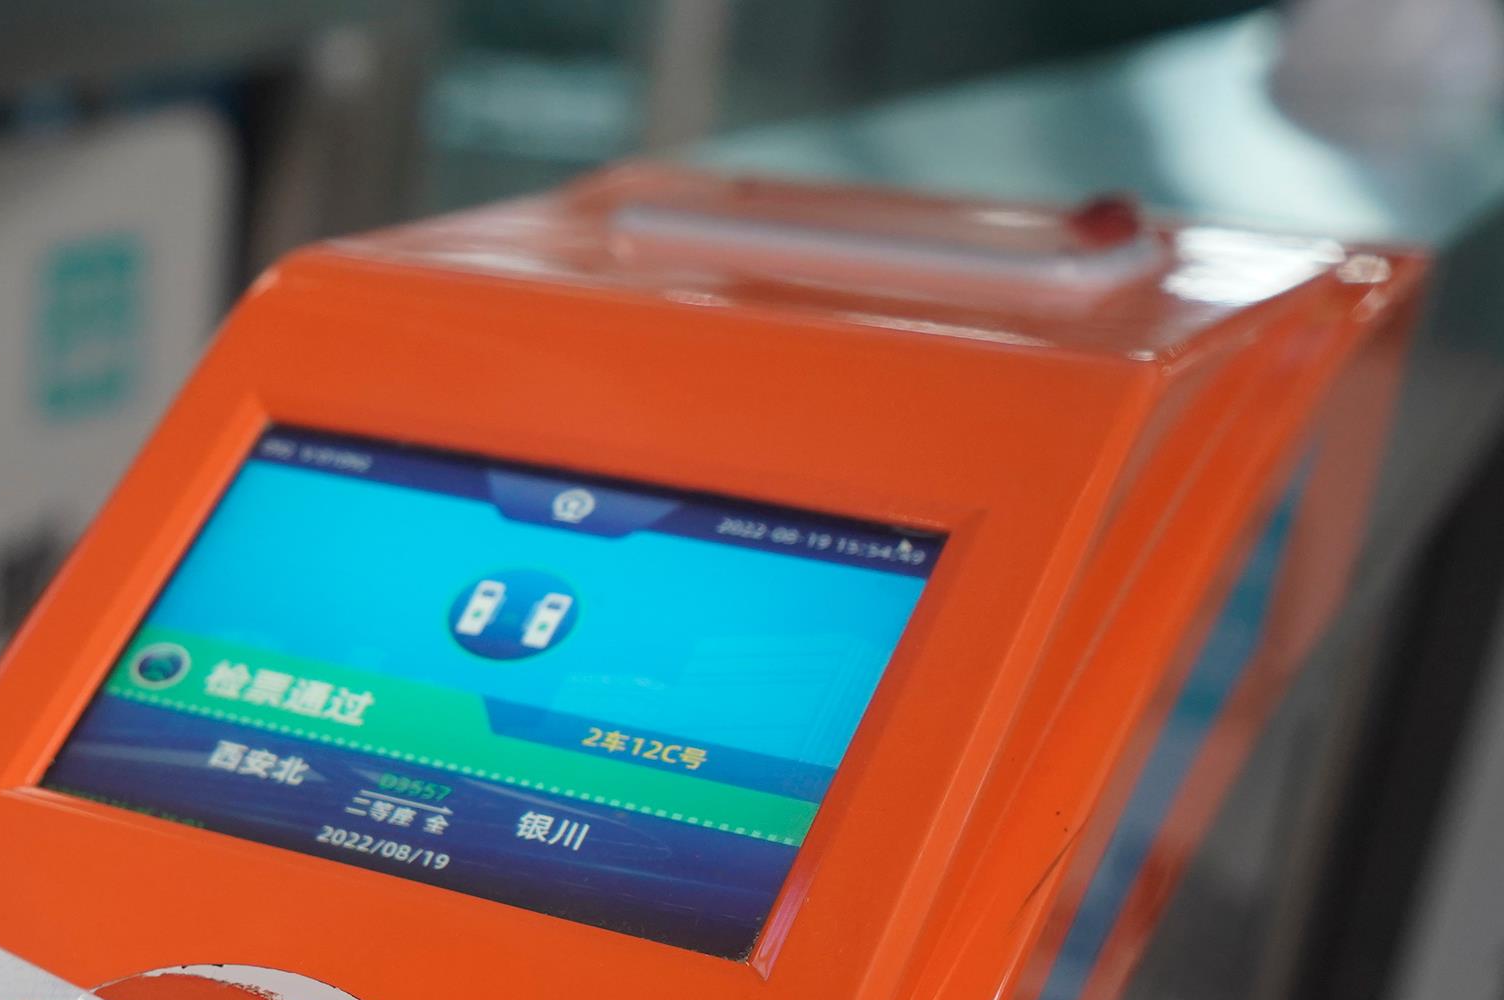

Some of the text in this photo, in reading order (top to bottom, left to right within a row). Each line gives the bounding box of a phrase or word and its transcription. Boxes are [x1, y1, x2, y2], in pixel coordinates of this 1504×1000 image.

[204, 660, 375, 726] 检票通过
[208, 739, 310, 786] 西安北
[581, 726, 708, 770] 2车12C号
[344, 796, 450, 836] 二等座 全
[515, 810, 591, 851] 银川
[316, 824, 451, 871] 2022/08/19
